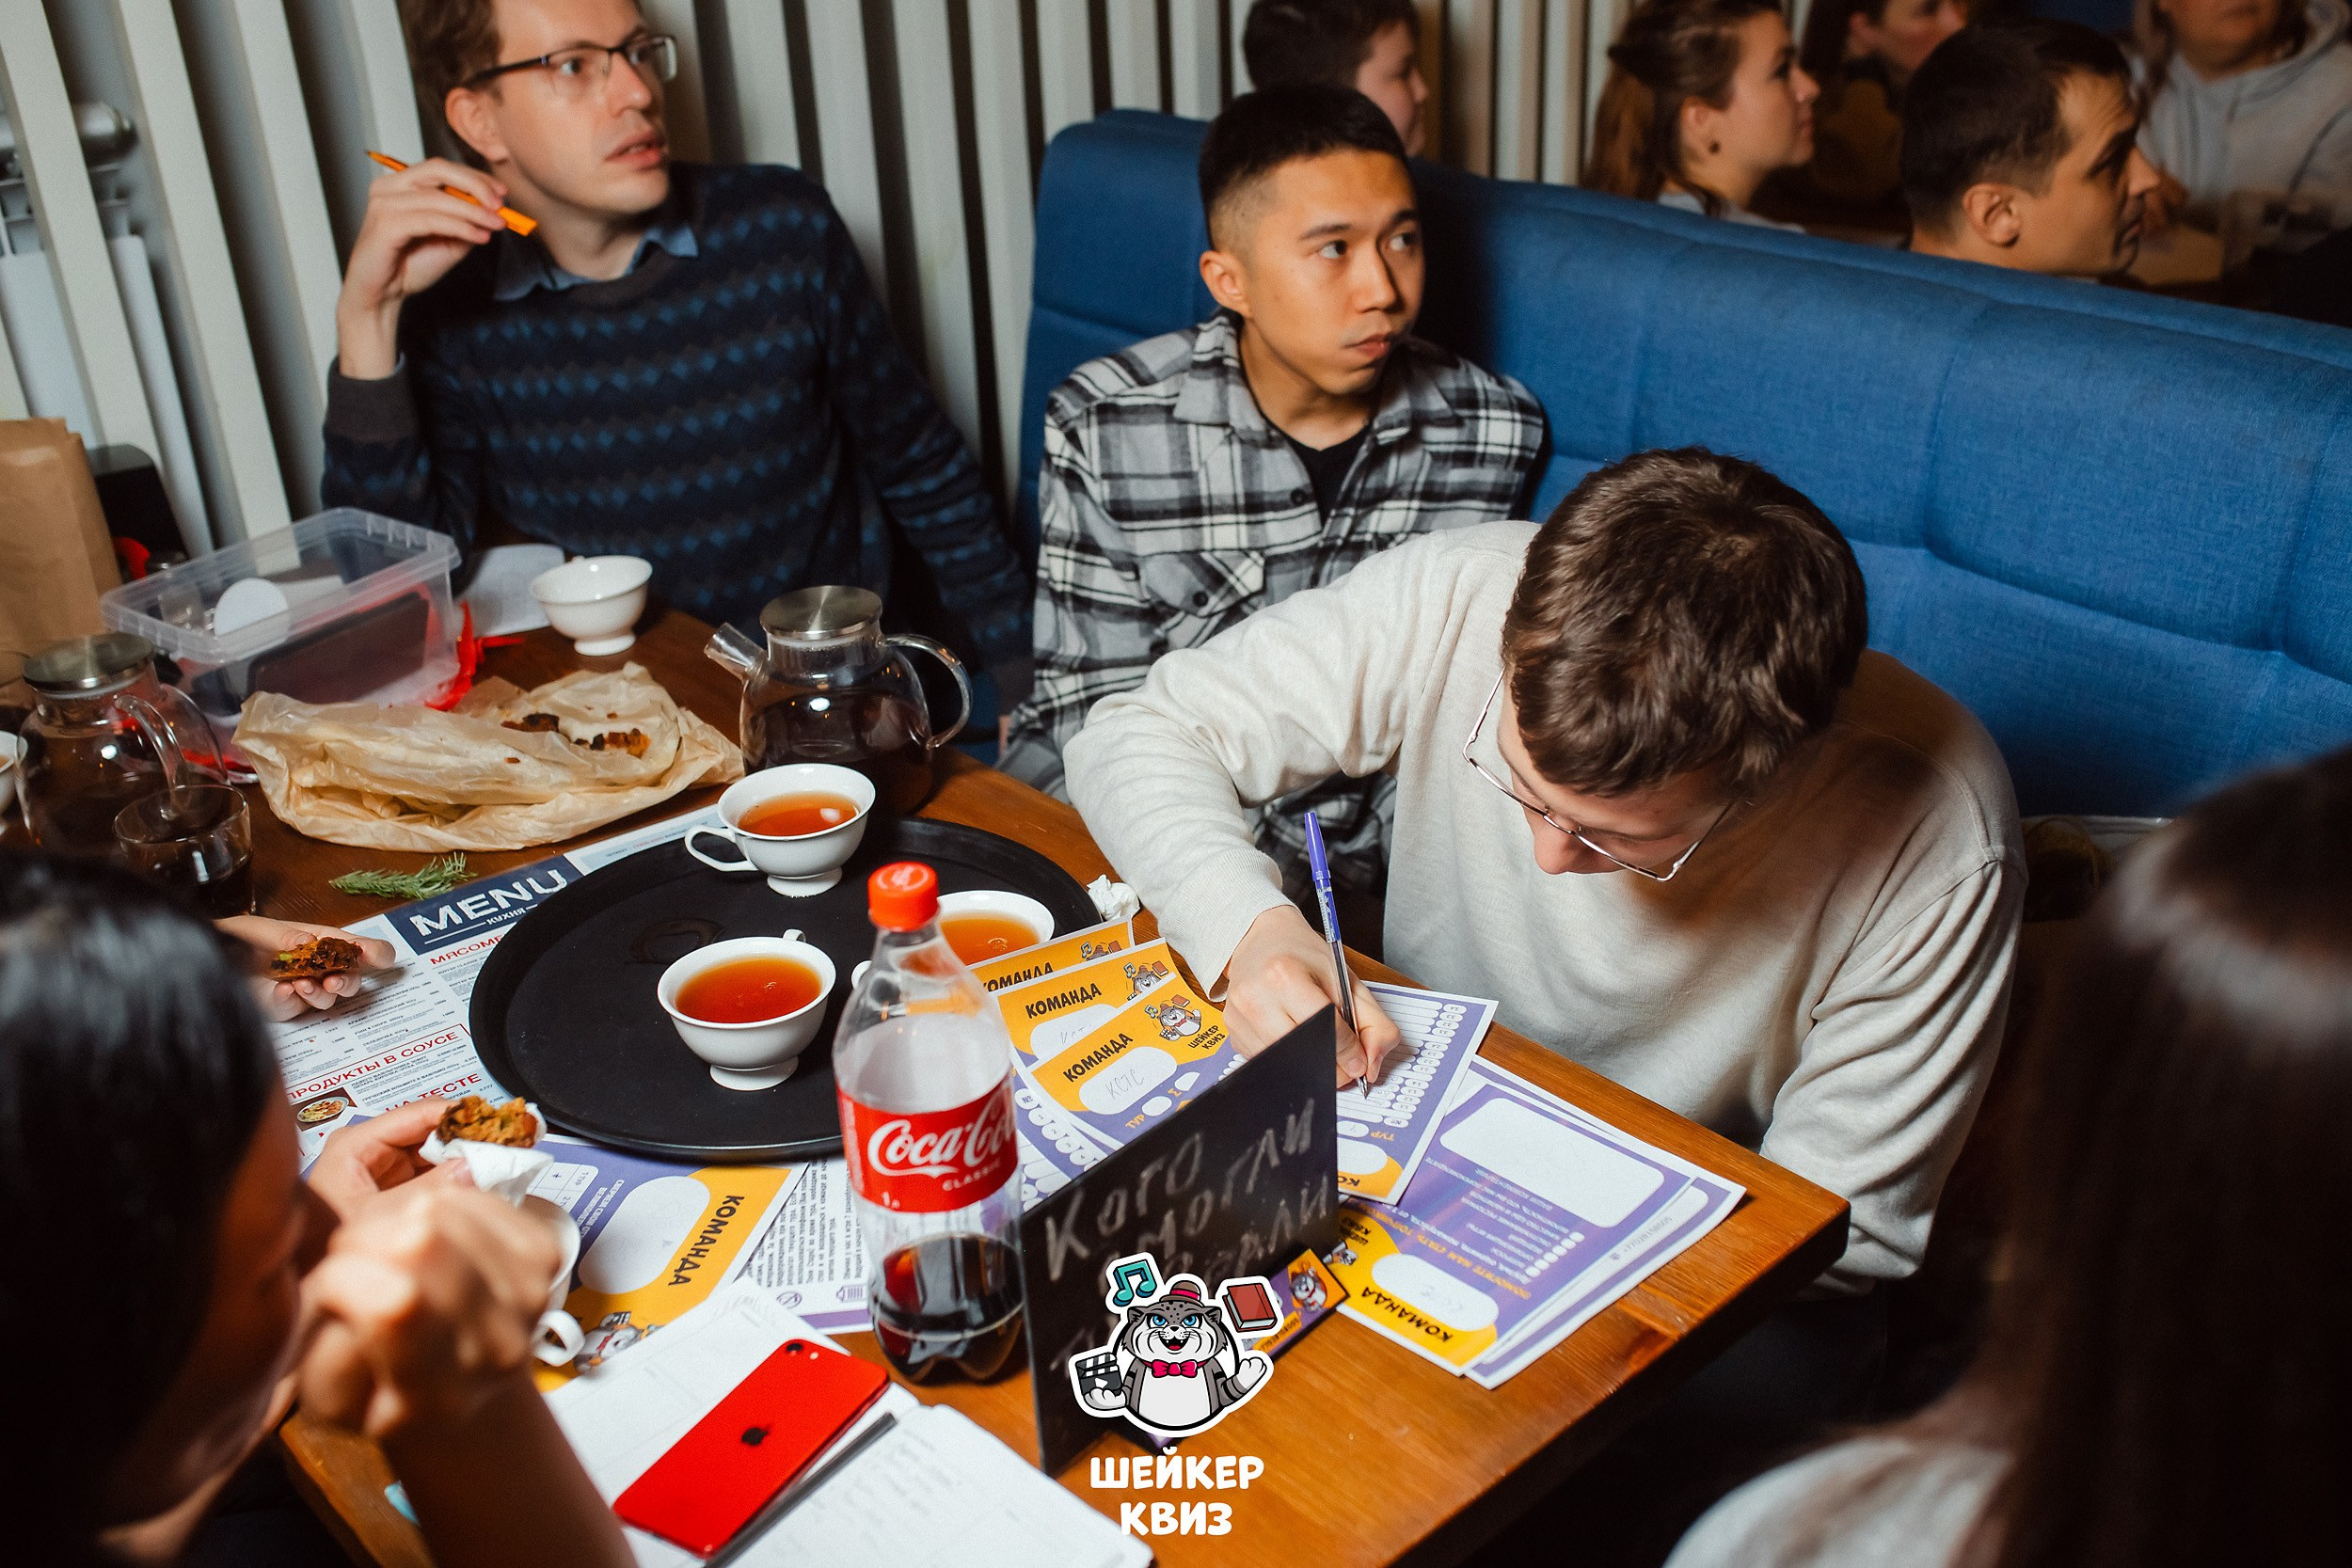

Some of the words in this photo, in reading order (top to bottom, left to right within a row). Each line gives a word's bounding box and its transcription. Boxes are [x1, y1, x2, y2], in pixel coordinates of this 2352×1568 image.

[409, 869, 567, 936] MENU
[485, 908, 526, 926] КУХНЯ
[983, 962, 1054, 992] ОМАНДА
[1025, 982, 1103, 1019] КОМАНДА
[1187, 1024, 1220, 1049] ШЕЙКЕР
[1201, 1033, 1227, 1051] КВИЗ
[287, 1060, 381, 1099] ПРОДУКТЫ
[384, 1054, 398, 1065] В
[401, 1031, 459, 1057] СОУСЕ
[1062, 1033, 1134, 1083] КОМАНДА
[418, 1073, 482, 1098] ТЕСТЕ
[1124, 1114, 1146, 1130] ТУР
[1370, 1131, 1395, 1142] ТУР
[668, 1195, 745, 1287] КОМАНДА
[1361, 1287, 1454, 1342] КОМАНДА
